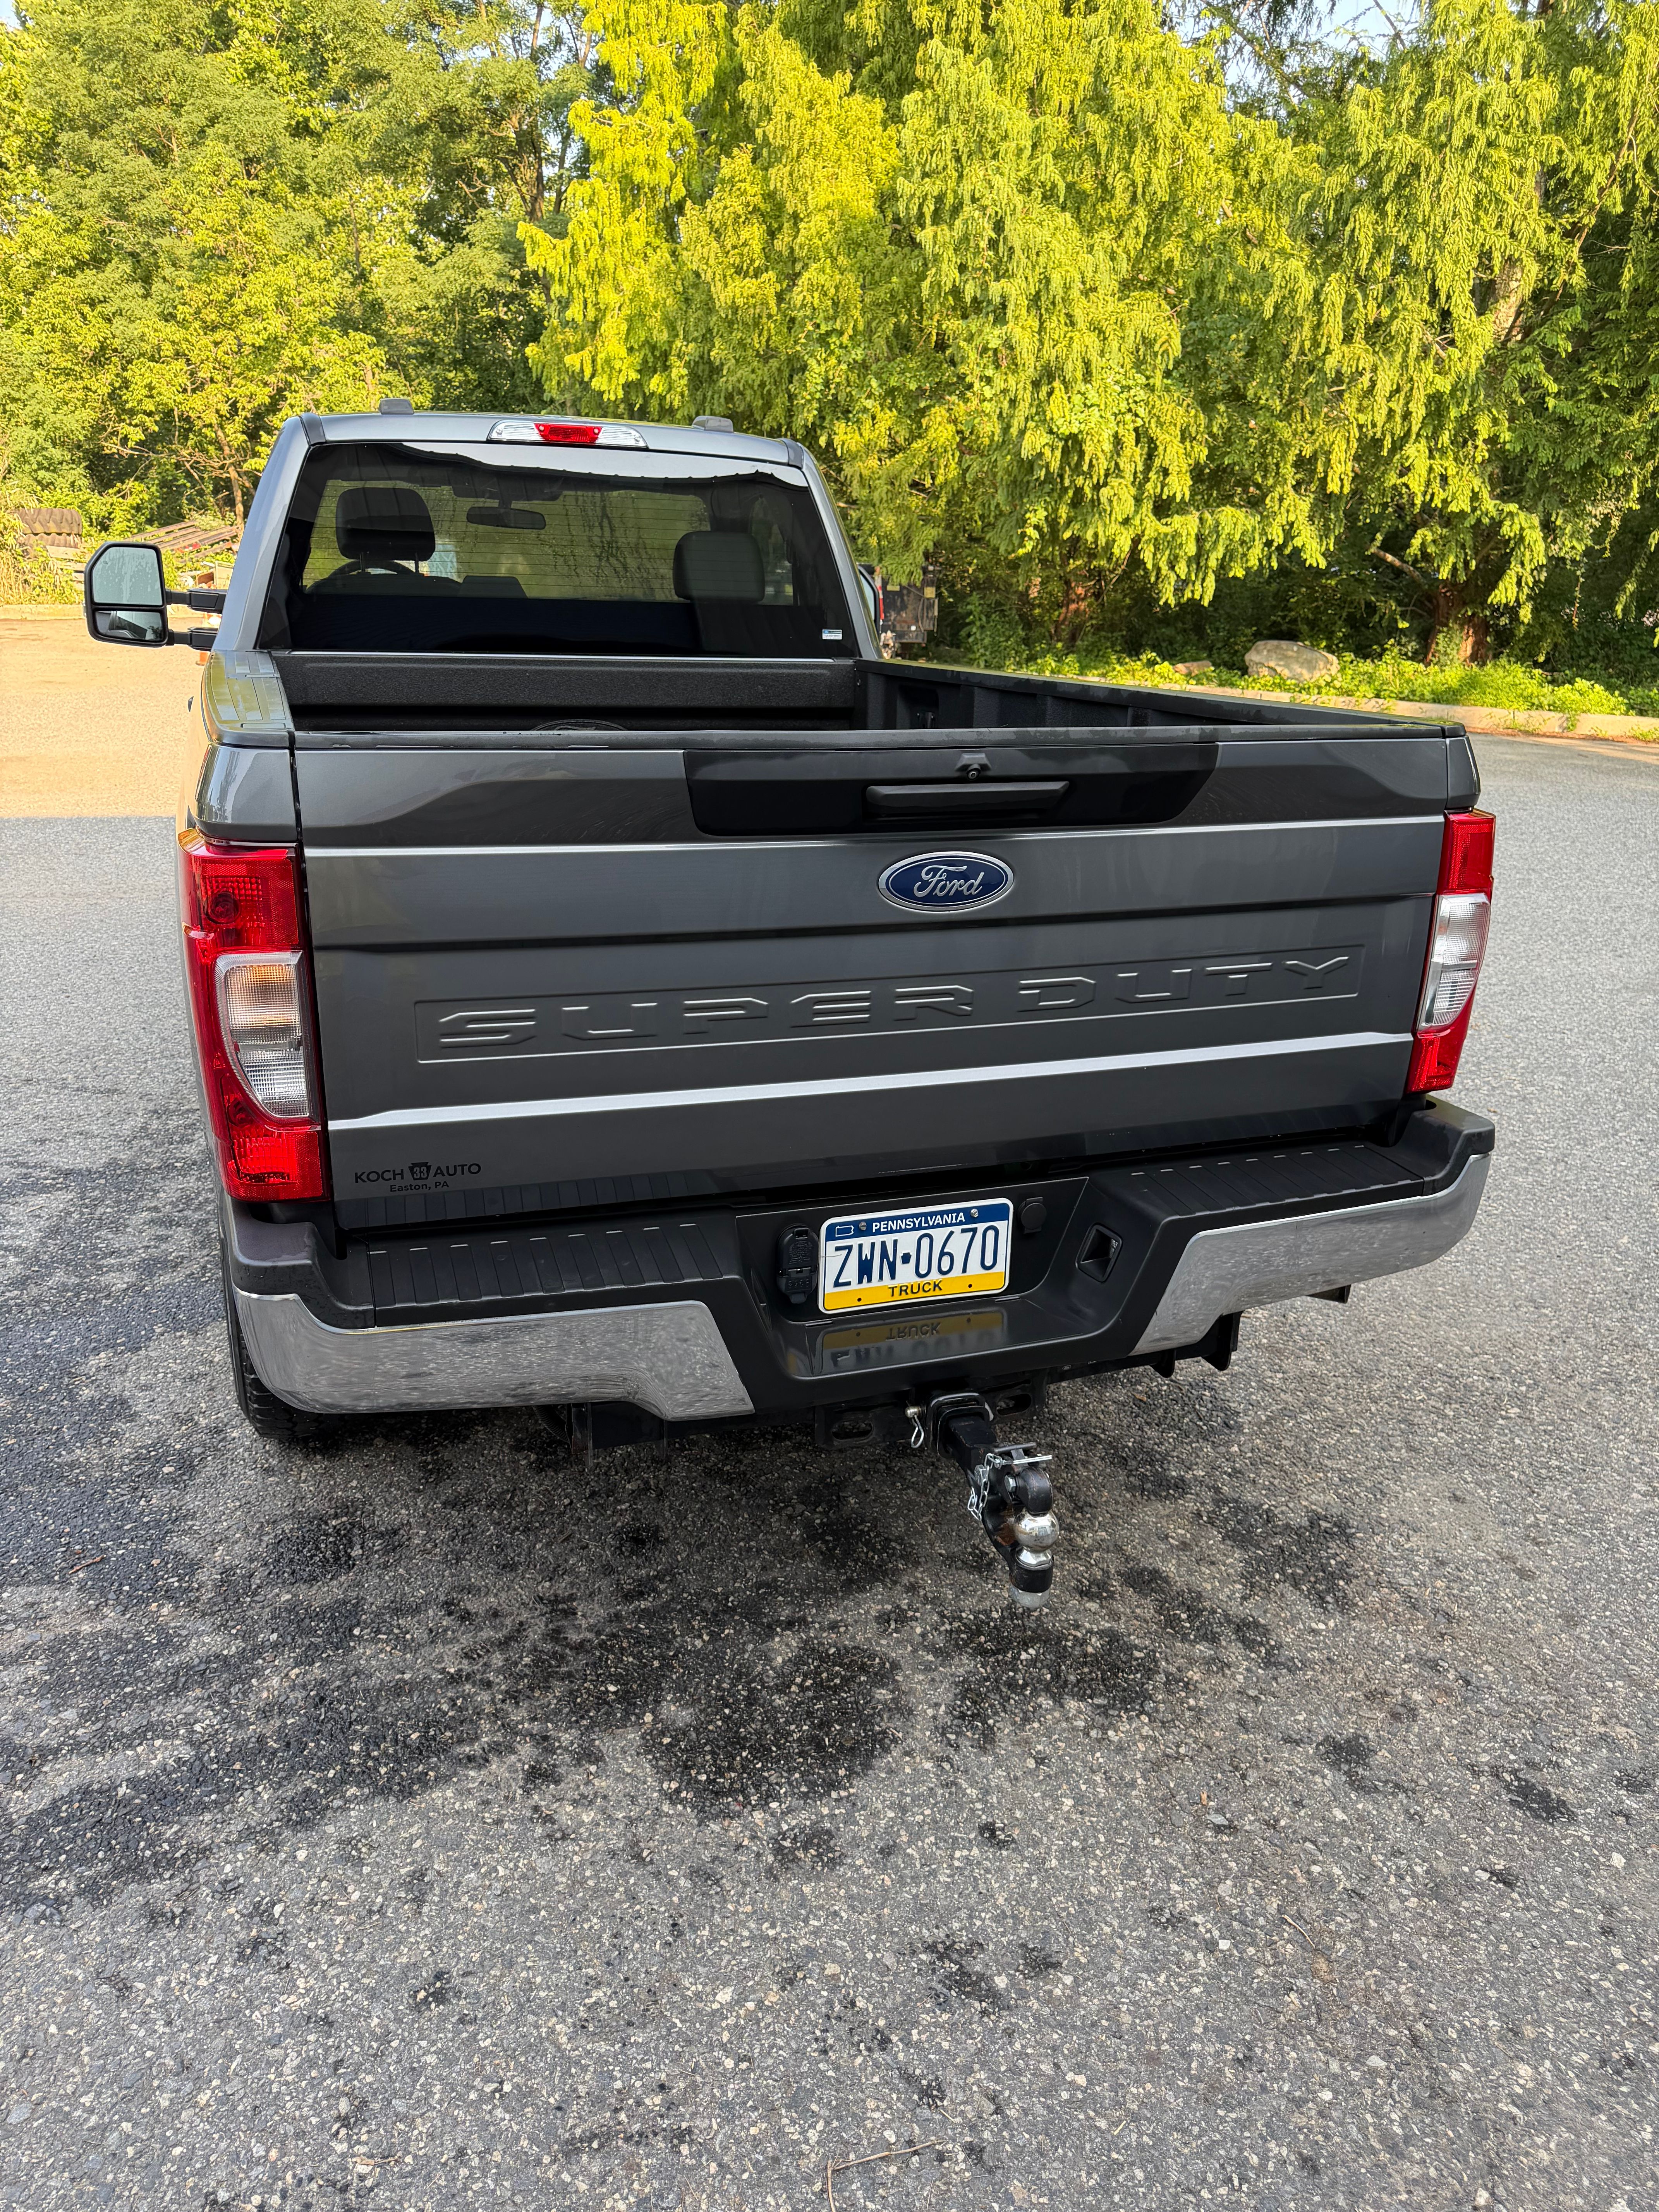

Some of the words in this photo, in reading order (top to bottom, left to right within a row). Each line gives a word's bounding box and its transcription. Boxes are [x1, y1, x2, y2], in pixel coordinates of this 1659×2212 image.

[913, 865, 985, 897] Ford
[439, 985, 974, 1048] SUPER
[1018, 956, 1350, 1012] DUTY
[354, 1169, 404, 1183] KOCH
[413, 1166, 427, 1179] 33
[433, 1163, 481, 1178] AUTO
[390, 1183, 431, 1192] Easton,
[434, 1181, 449, 1189] PA
[872, 1212, 965, 1233] PENNSYLVANIA
[888, 1279, 943, 1297] TRUCK
